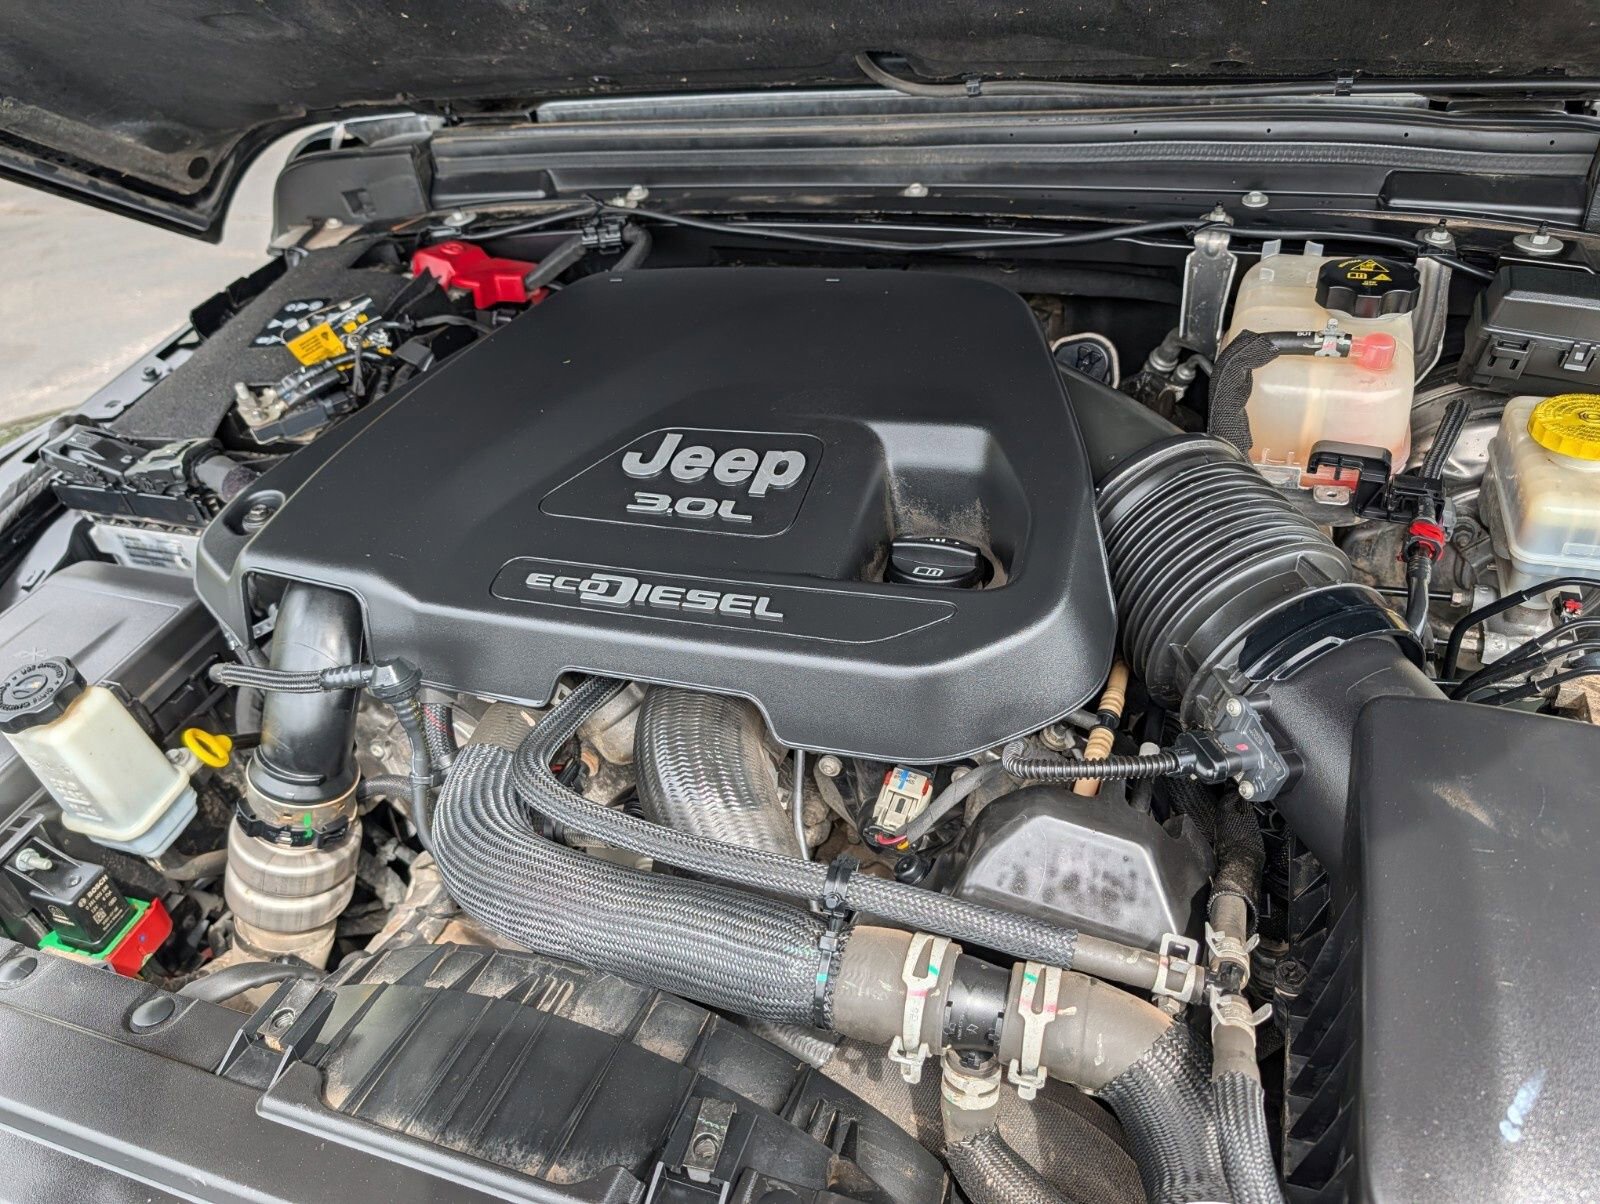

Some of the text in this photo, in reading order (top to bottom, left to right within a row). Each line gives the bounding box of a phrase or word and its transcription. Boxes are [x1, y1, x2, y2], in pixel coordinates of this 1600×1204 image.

[621, 432, 807, 498] Jeep
[626, 491, 753, 524] 3.0L
[525, 572, 784, 622] ECODIESEL
[87, 874, 109, 898] BOSCH
